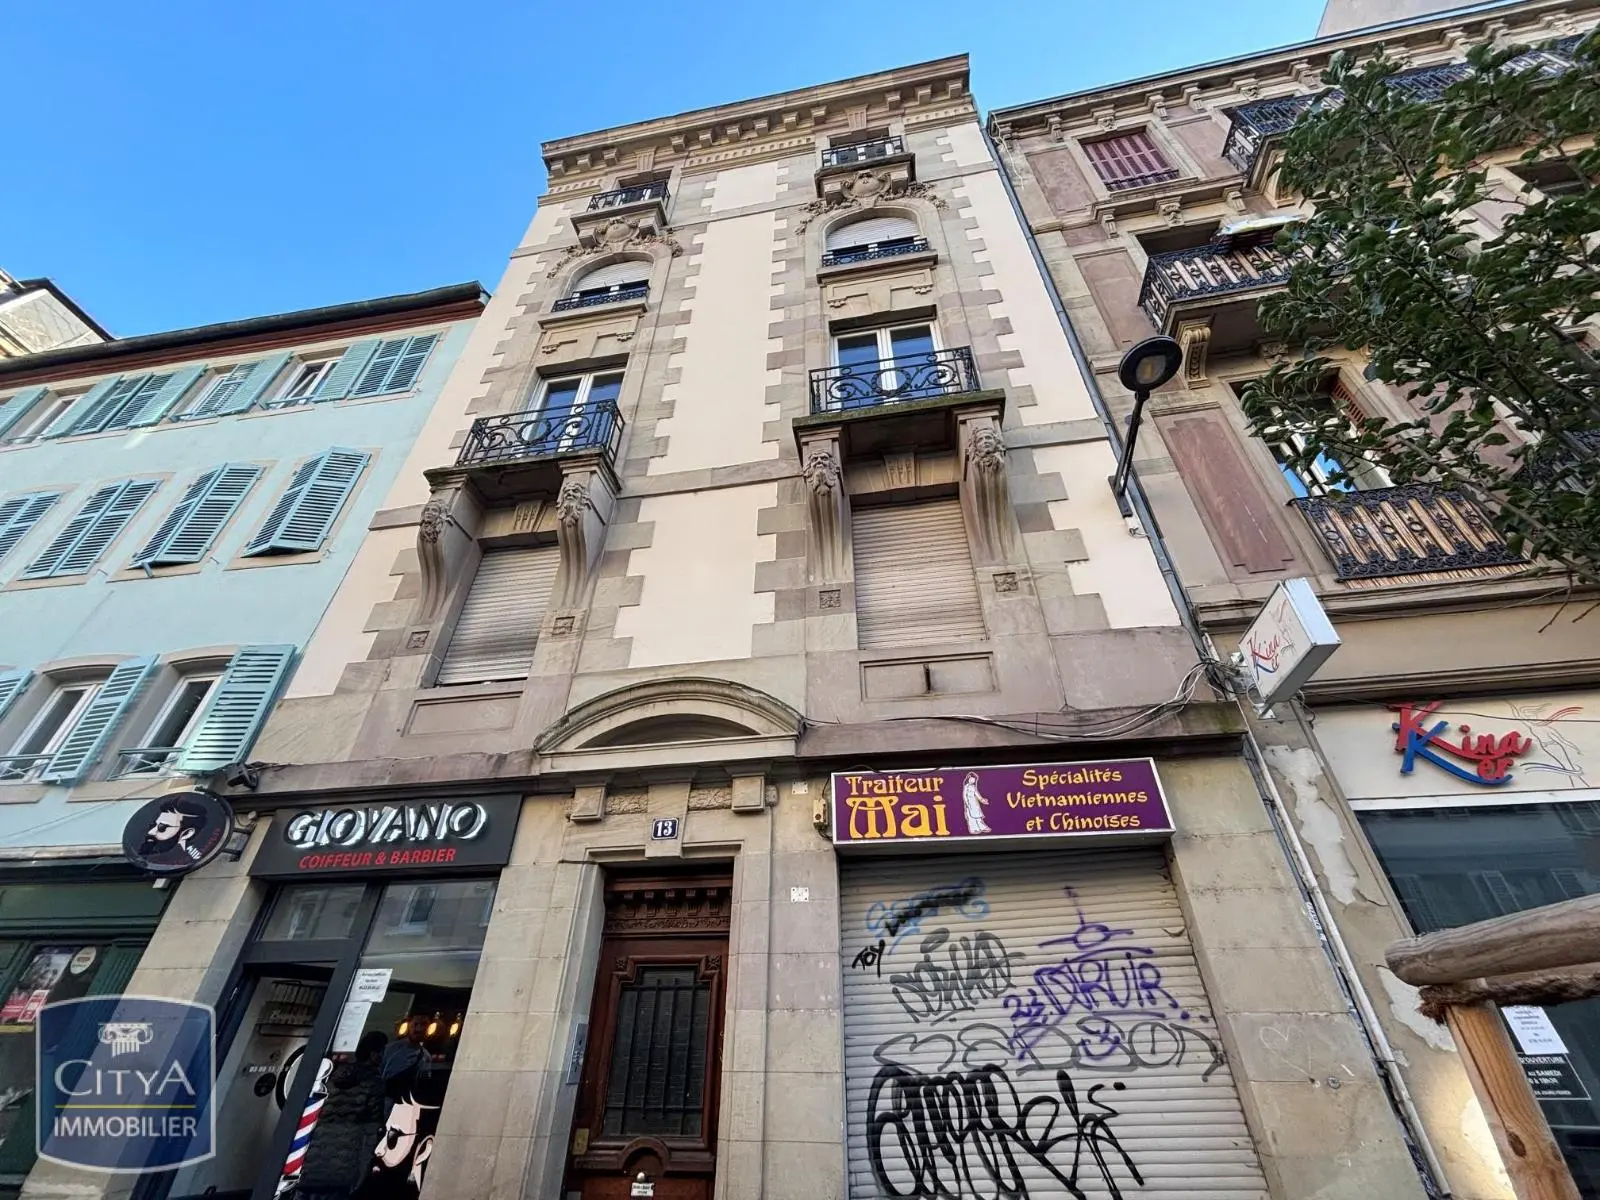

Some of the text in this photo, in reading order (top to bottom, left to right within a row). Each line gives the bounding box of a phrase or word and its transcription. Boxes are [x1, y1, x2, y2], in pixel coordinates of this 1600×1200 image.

[845, 775, 944, 796] Traiteur
[1022, 768, 1122, 790] Spécialités
[1006, 791, 1148, 808] Vietnamiennes
[285, 801, 487, 849] GIOVANO
[846, 795, 950, 839] Mai
[1026, 812, 1141, 832] et Chinoises
[655, 820, 673, 837] 13
[300, 848, 457, 869] COIFFEUR & BARBIER
